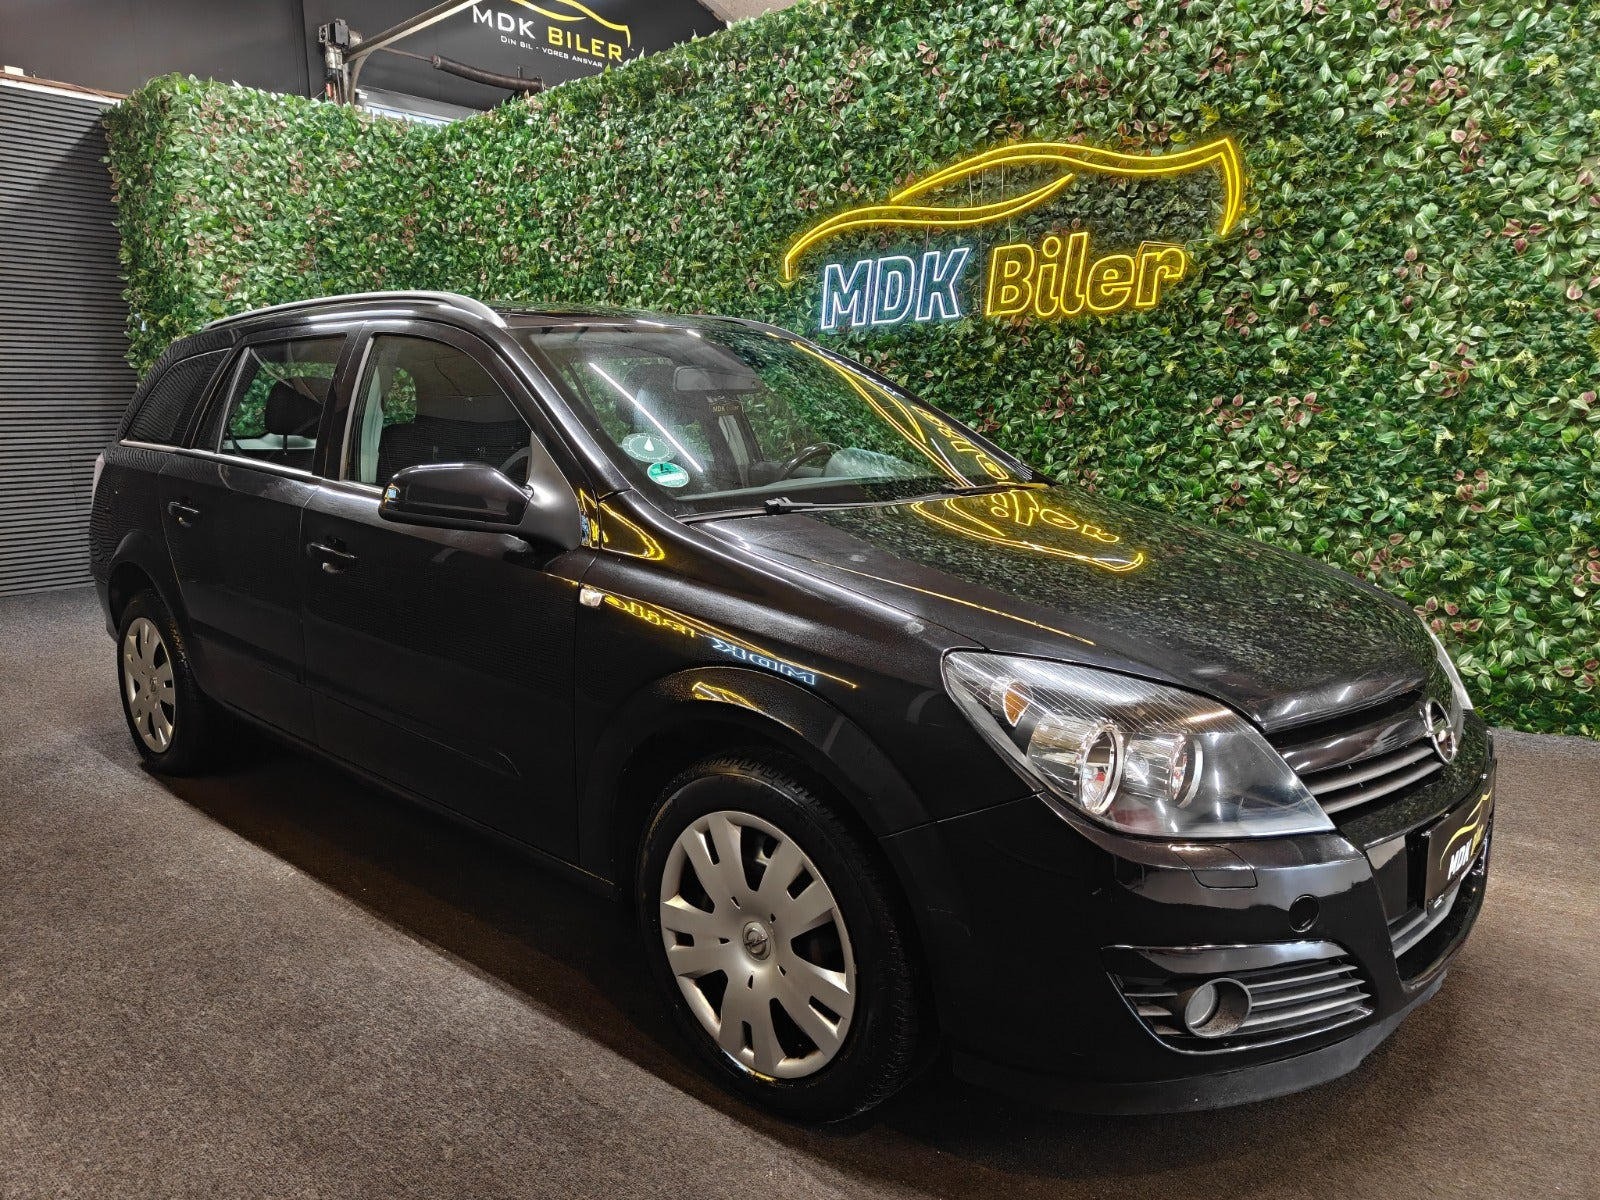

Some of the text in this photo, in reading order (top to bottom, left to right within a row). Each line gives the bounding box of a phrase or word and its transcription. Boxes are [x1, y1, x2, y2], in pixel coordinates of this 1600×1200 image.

[472, 4, 623, 63] MDK BILER
[519, 41, 533, 50] BIL
[571, 55, 603, 68] ANSVAR
[820, 231, 1188, 330] MDK Biler
